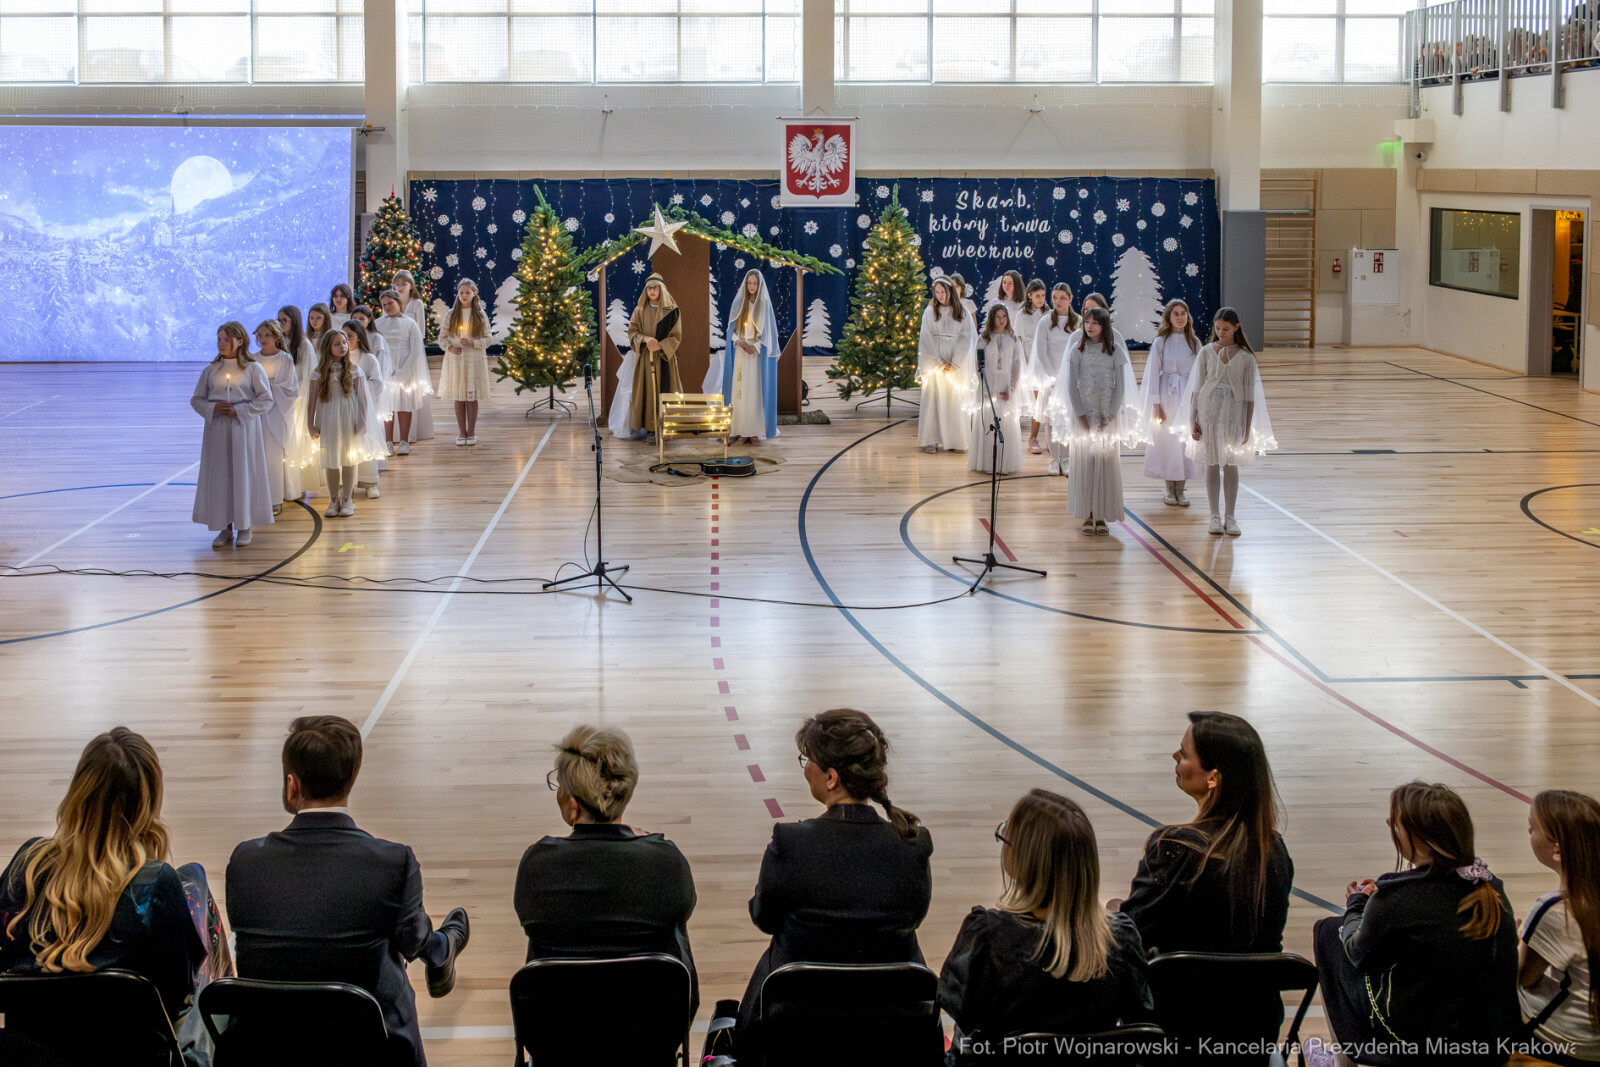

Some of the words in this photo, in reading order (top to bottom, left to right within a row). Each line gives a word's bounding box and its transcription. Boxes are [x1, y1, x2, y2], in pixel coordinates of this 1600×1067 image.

[955, 187, 1031, 210] Skarb,
[929, 212, 988, 240] który
[1000, 214, 1051, 233] trwa
